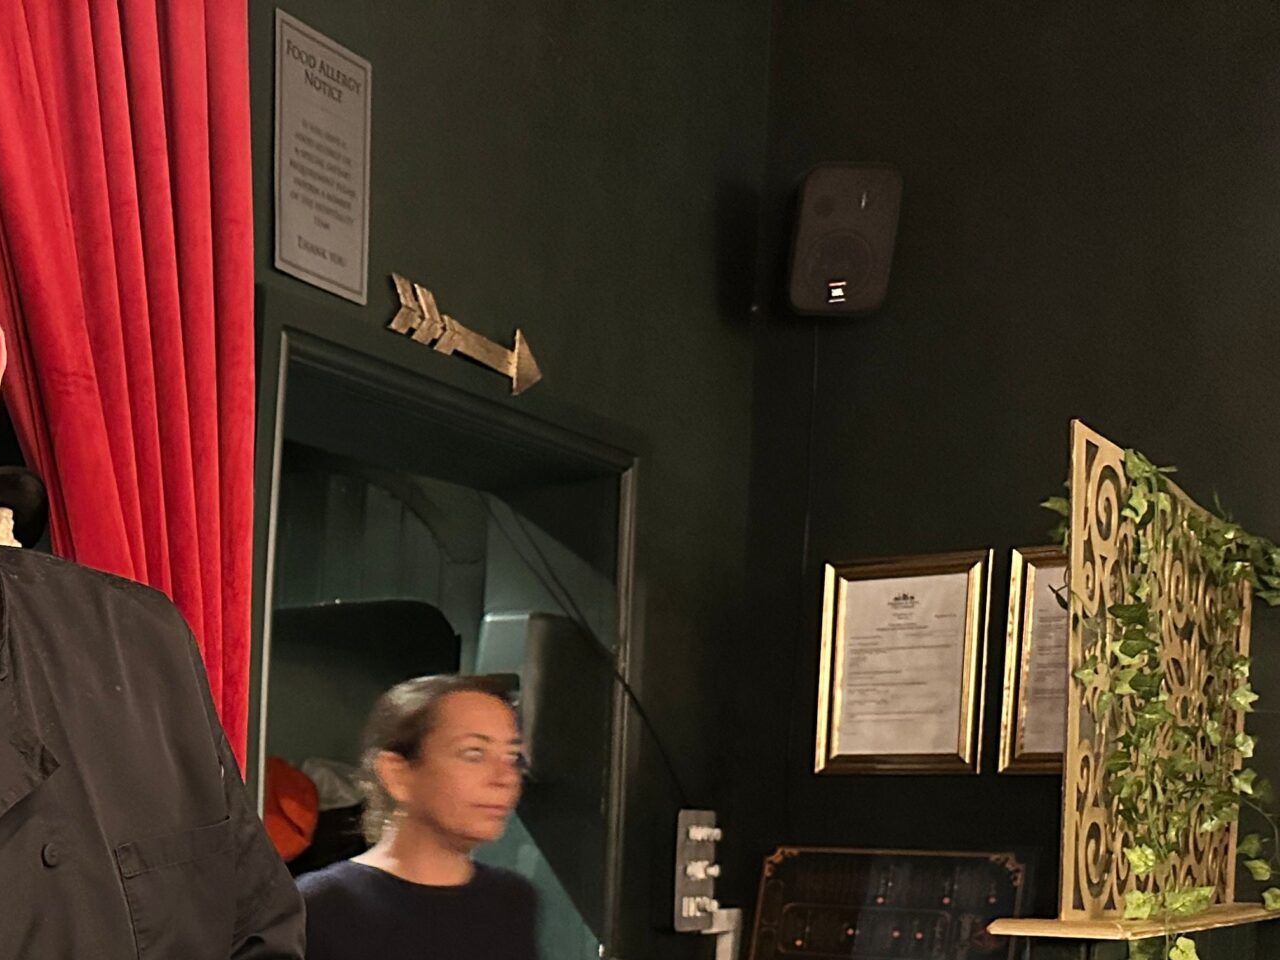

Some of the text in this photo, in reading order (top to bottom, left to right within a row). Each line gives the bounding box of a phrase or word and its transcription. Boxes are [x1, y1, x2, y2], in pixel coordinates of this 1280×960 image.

[286, 40, 361, 95] FOOD ALLERGY
[304, 68, 344, 104] NOTICE
